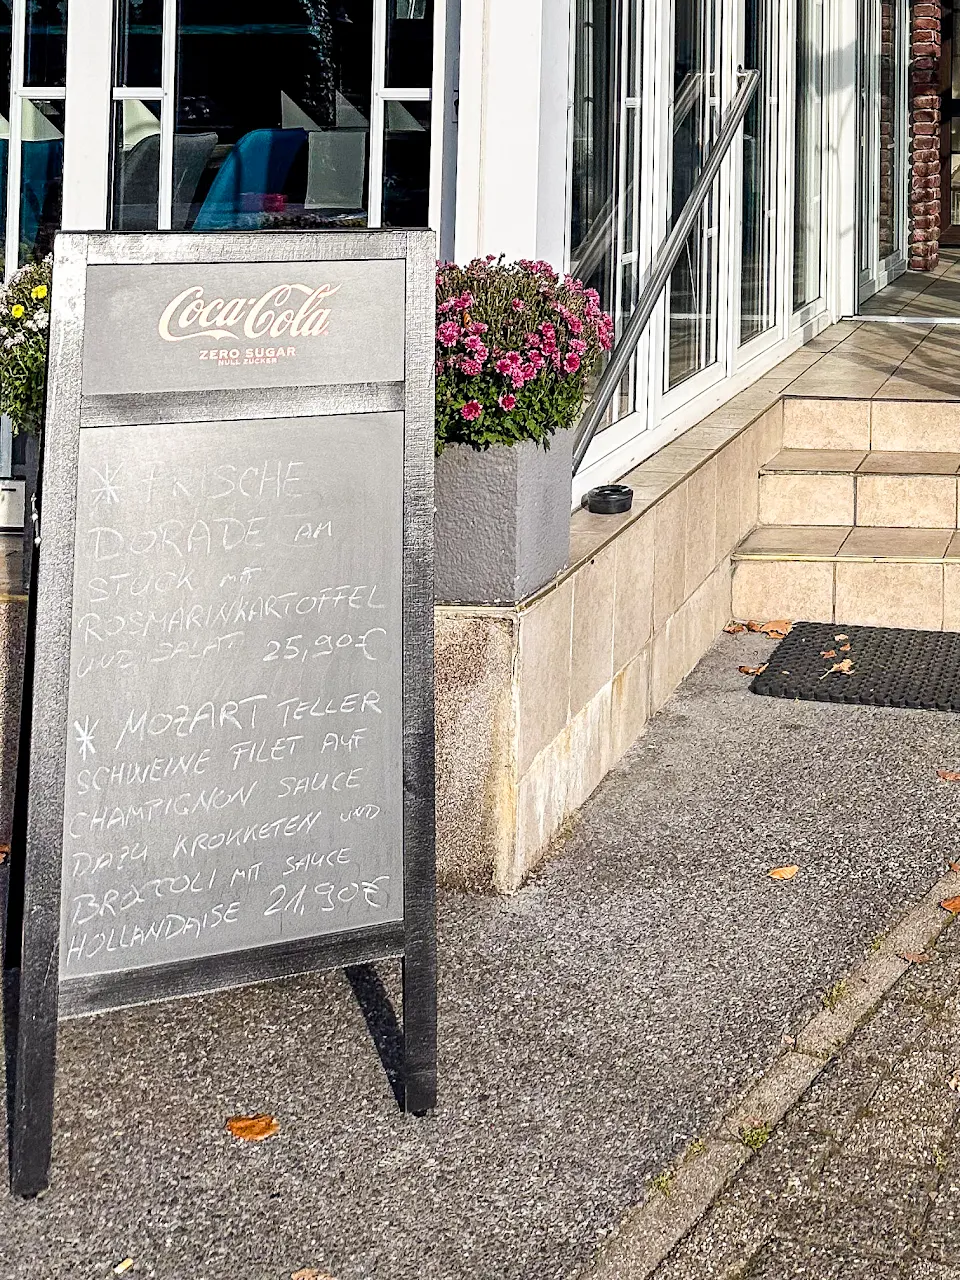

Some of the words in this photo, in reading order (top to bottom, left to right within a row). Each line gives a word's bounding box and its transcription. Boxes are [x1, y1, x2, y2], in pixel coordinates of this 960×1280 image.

[158, 283, 342, 342] Coca-Cola
[199, 347, 240, 360] ZERO
[245, 346, 297, 359] SUGAR
[217, 358, 241, 366] NULL
[243, 357, 279, 366] ZUCKER
[87, 516, 267, 561] DORADE
[115, 694, 268, 750] MOZART
[277, 689, 384, 728] TELLER
[77, 748, 211, 795] SCHWEINE
[230, 735, 305, 771] FILET
[69, 780, 259, 839] CHAMPIGNON
[277, 767, 364, 799] SAUCE
[172, 810, 322, 860] KROKKETEN
[340, 803, 382, 823] UND
[229, 861, 263, 888] MIT
[283, 847, 351, 877] SAUCE
[66, 901, 242, 967] HOLLANDAISE
